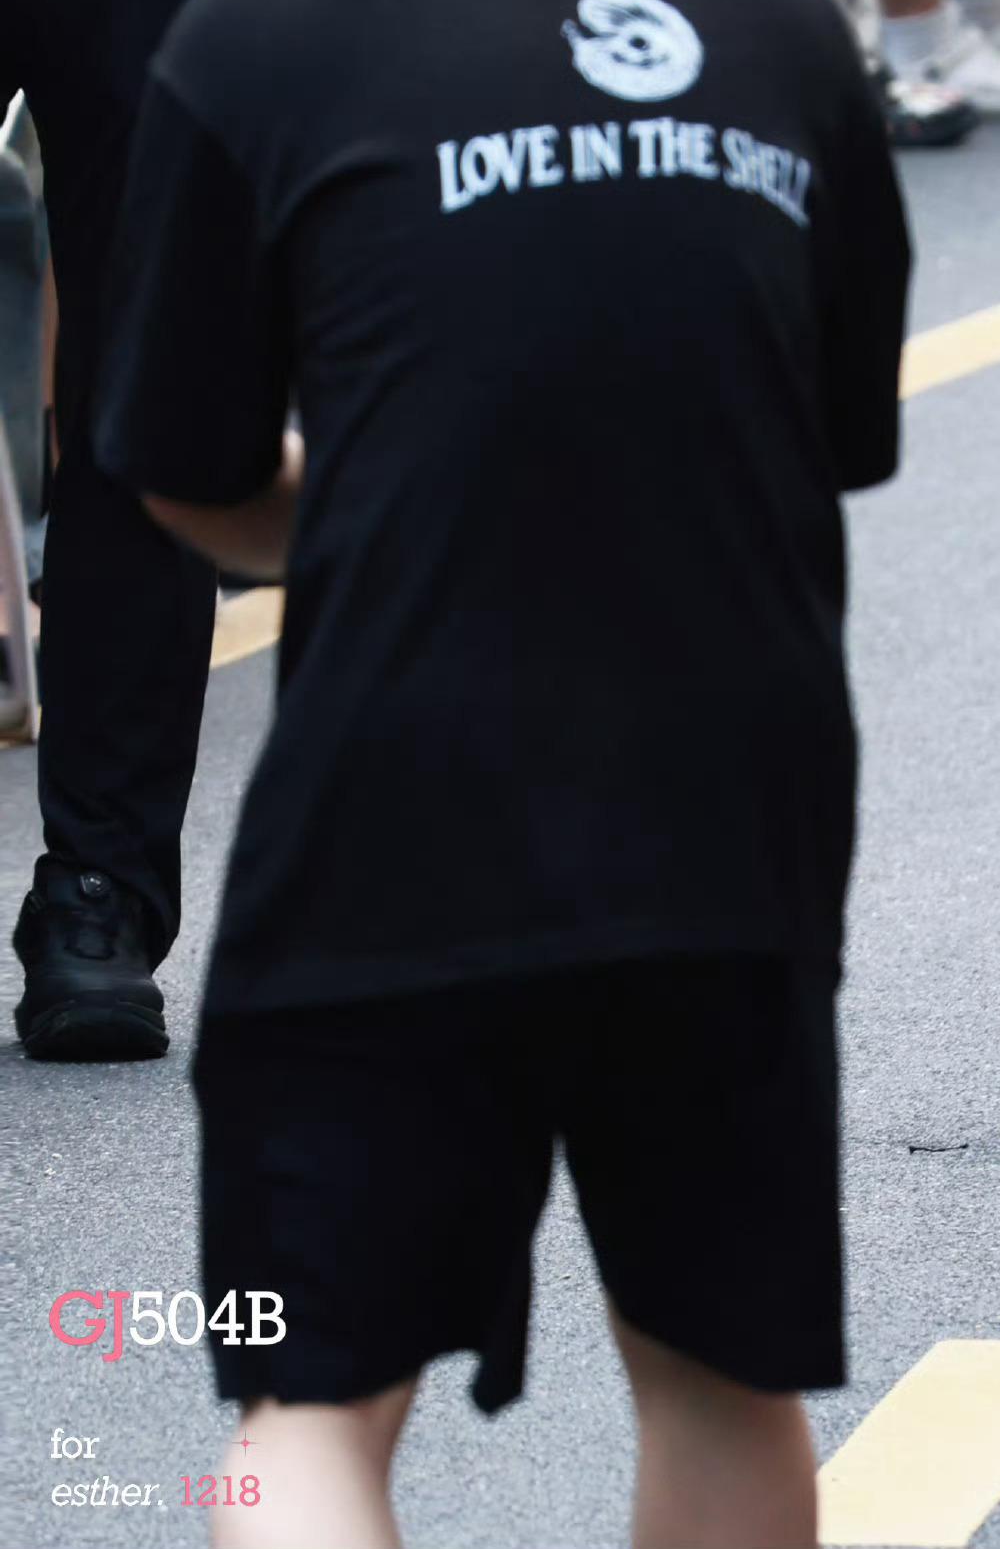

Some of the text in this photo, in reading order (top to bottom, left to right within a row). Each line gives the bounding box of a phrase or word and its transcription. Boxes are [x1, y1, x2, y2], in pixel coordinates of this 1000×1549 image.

[437, 125, 564, 214] LOVE
[569, 122, 621, 182] IN
[628, 116, 721, 181] THE
